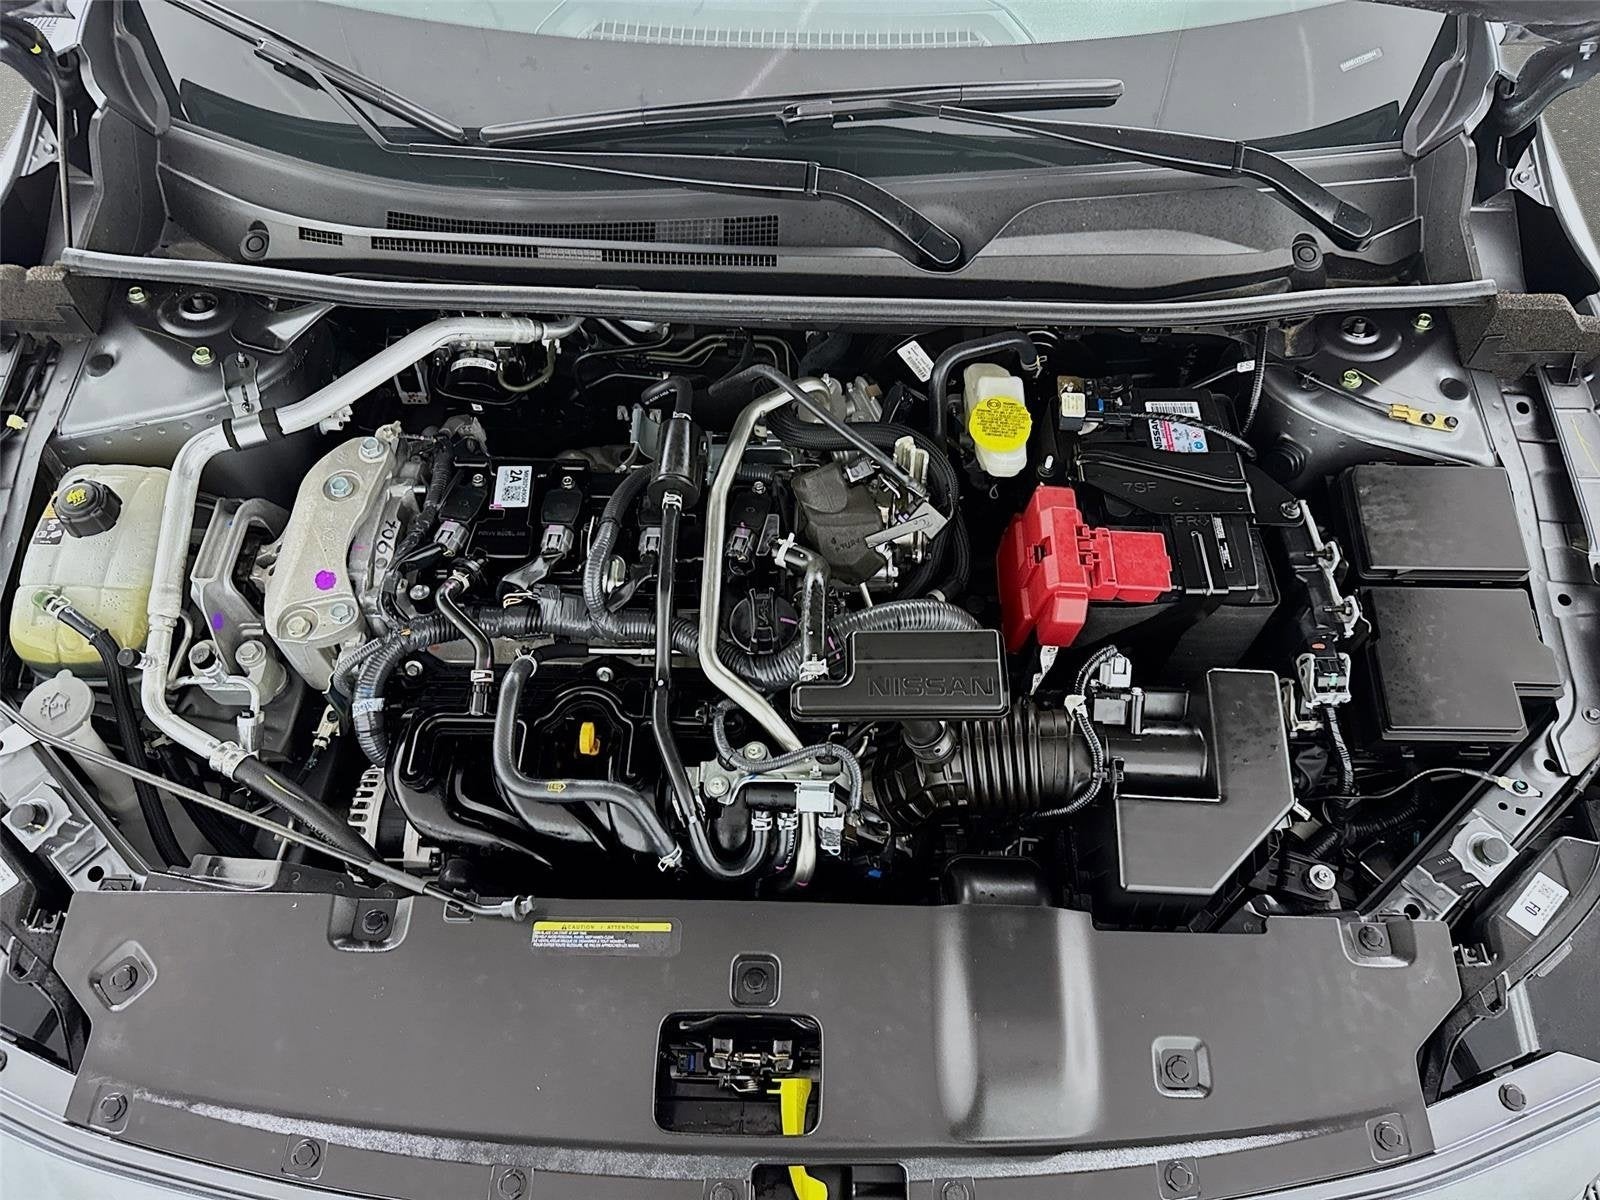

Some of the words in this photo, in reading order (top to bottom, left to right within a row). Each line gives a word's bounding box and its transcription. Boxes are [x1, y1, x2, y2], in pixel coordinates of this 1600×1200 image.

[509, 469, 523, 483] 2A
[1122, 481, 1158, 493] 7SF
[866, 676, 995, 697] NISSAN
